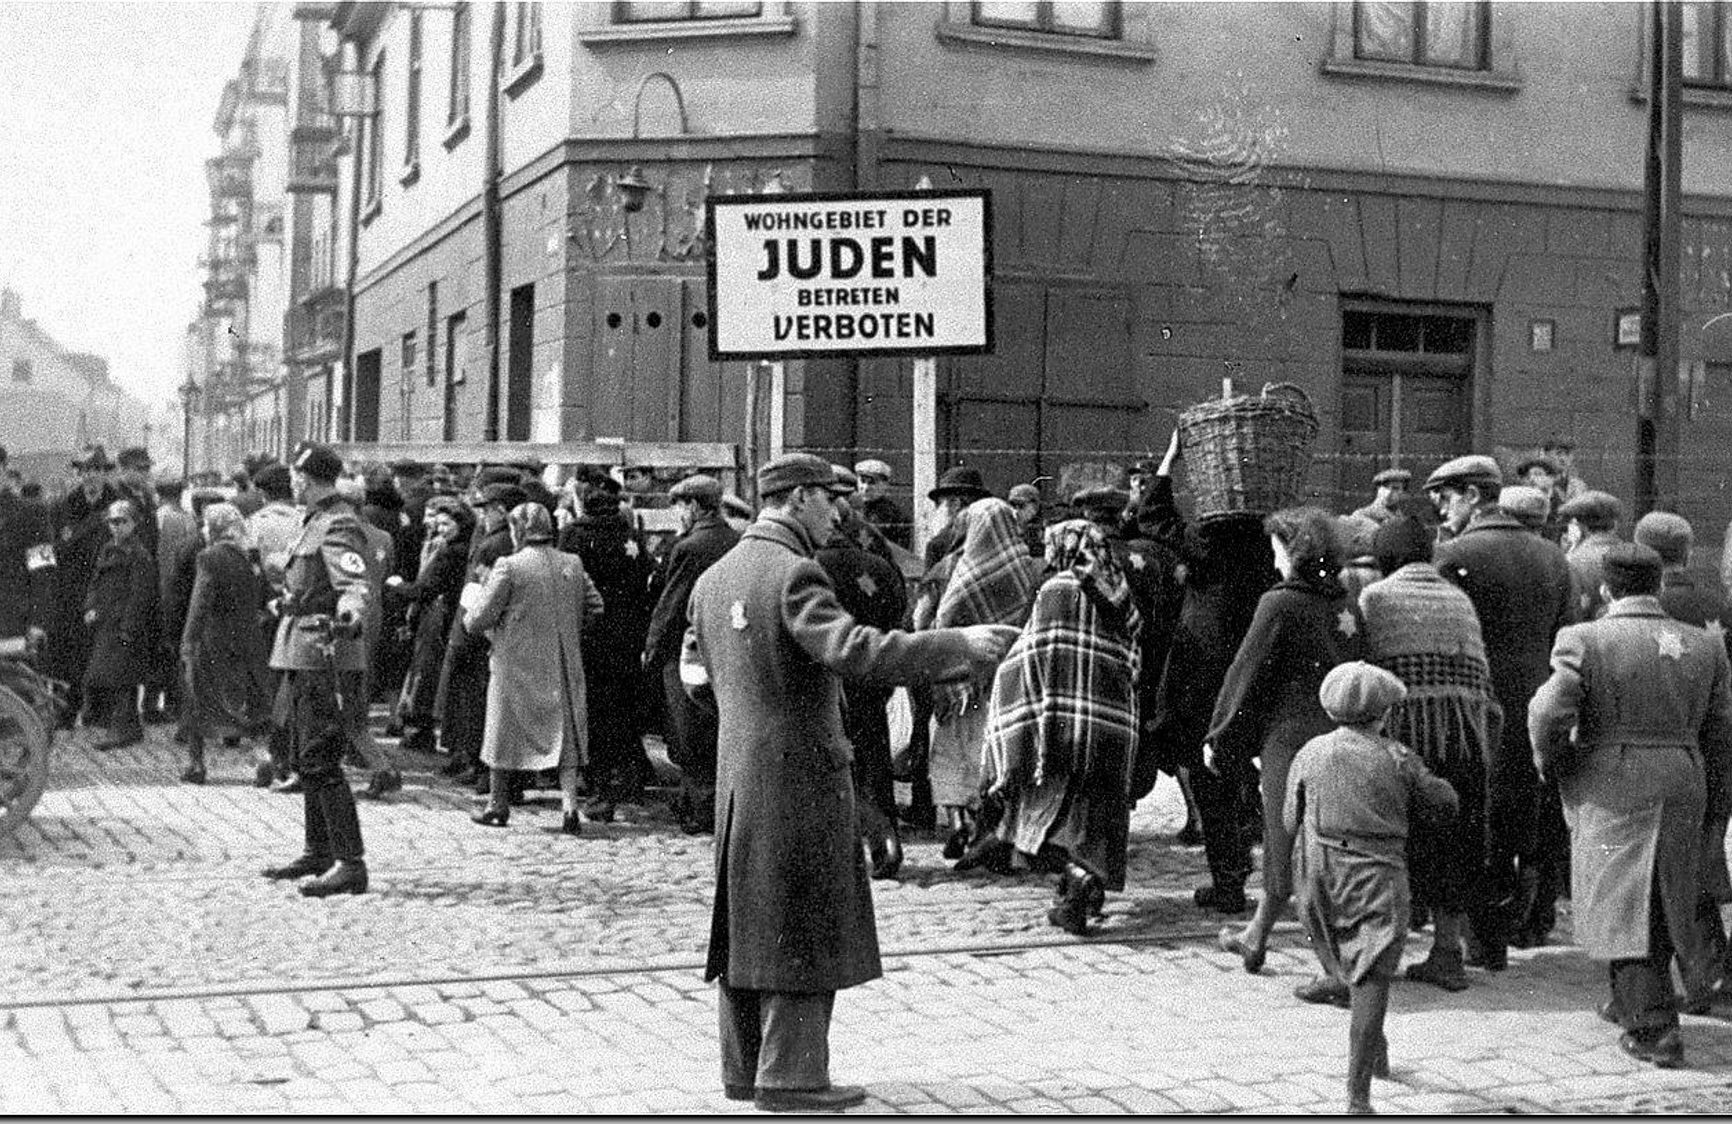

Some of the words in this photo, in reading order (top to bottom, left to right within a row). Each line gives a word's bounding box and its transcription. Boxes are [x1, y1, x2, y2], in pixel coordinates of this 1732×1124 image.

[744, 210, 887, 231] WOHNGEBIET
[903, 208, 952, 228] DER
[757, 235, 937, 281] JUDEN
[797, 287, 900, 307] BETRETEN
[773, 312, 935, 341] VERBOTEN
